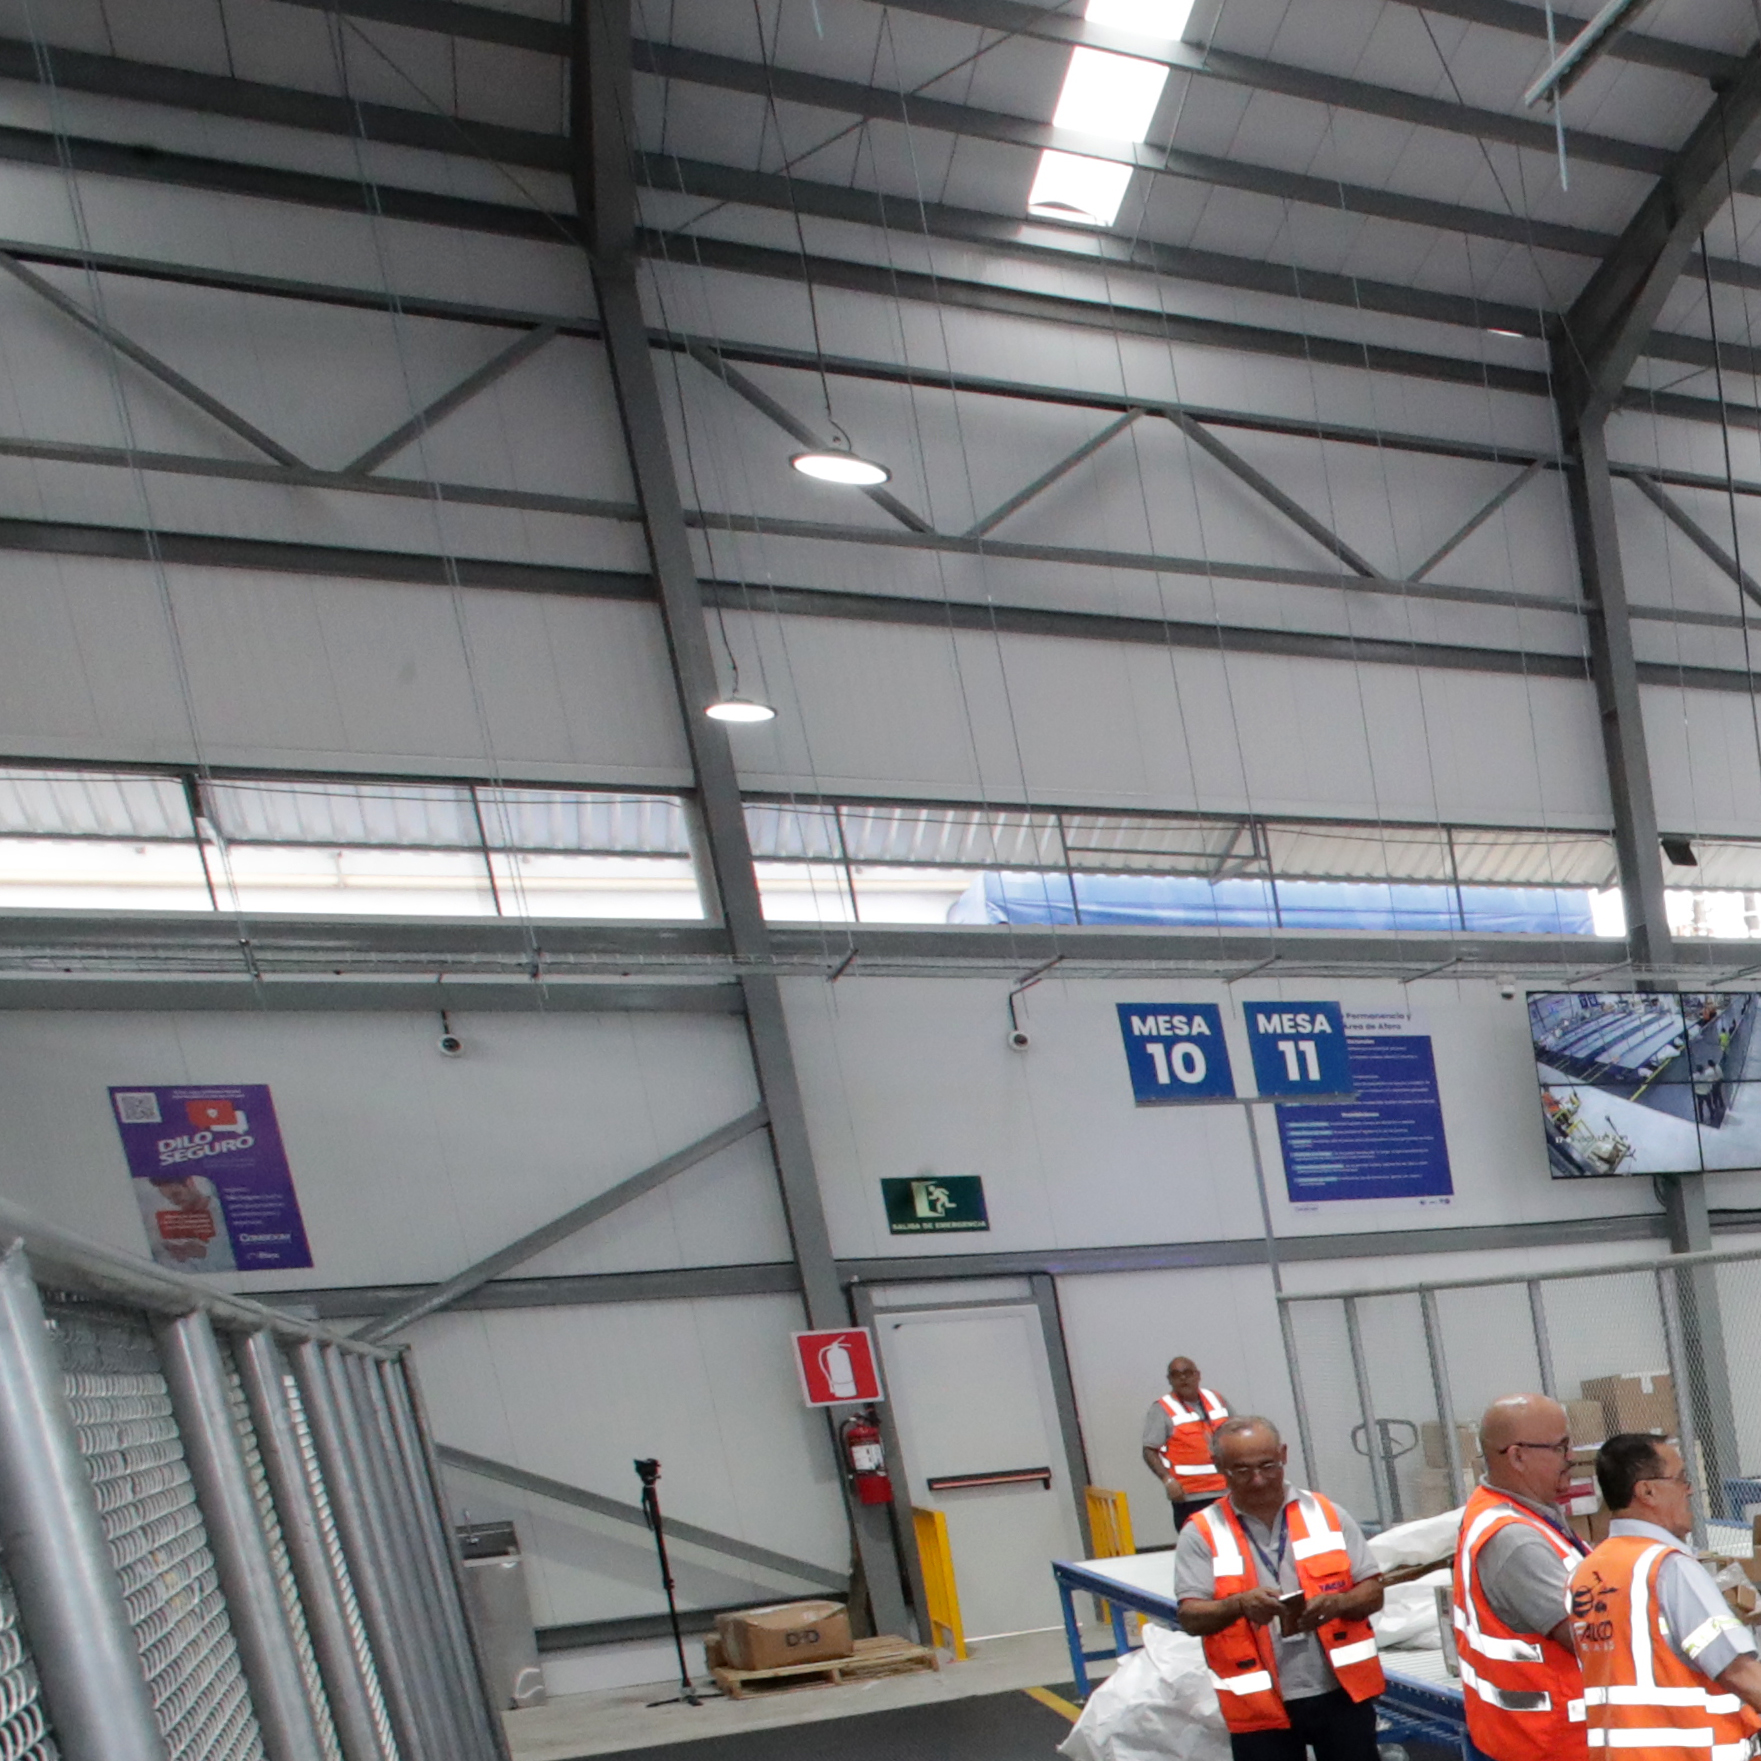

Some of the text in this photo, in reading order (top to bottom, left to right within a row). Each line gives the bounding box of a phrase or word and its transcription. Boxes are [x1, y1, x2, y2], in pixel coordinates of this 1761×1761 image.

[1131, 1014, 1210, 1036] MESA
[1257, 1013, 1332, 1035] MESA
[1346, 1011, 1405, 1020] Permanencia
[1366, 1021, 1401, 1030] de Aforo
[1146, 1042, 1207, 1084] 10
[1278, 1040, 1320, 1081] 11
[158, 1131, 213, 1152] DILO
[158, 1135, 254, 1166] SEGURO
